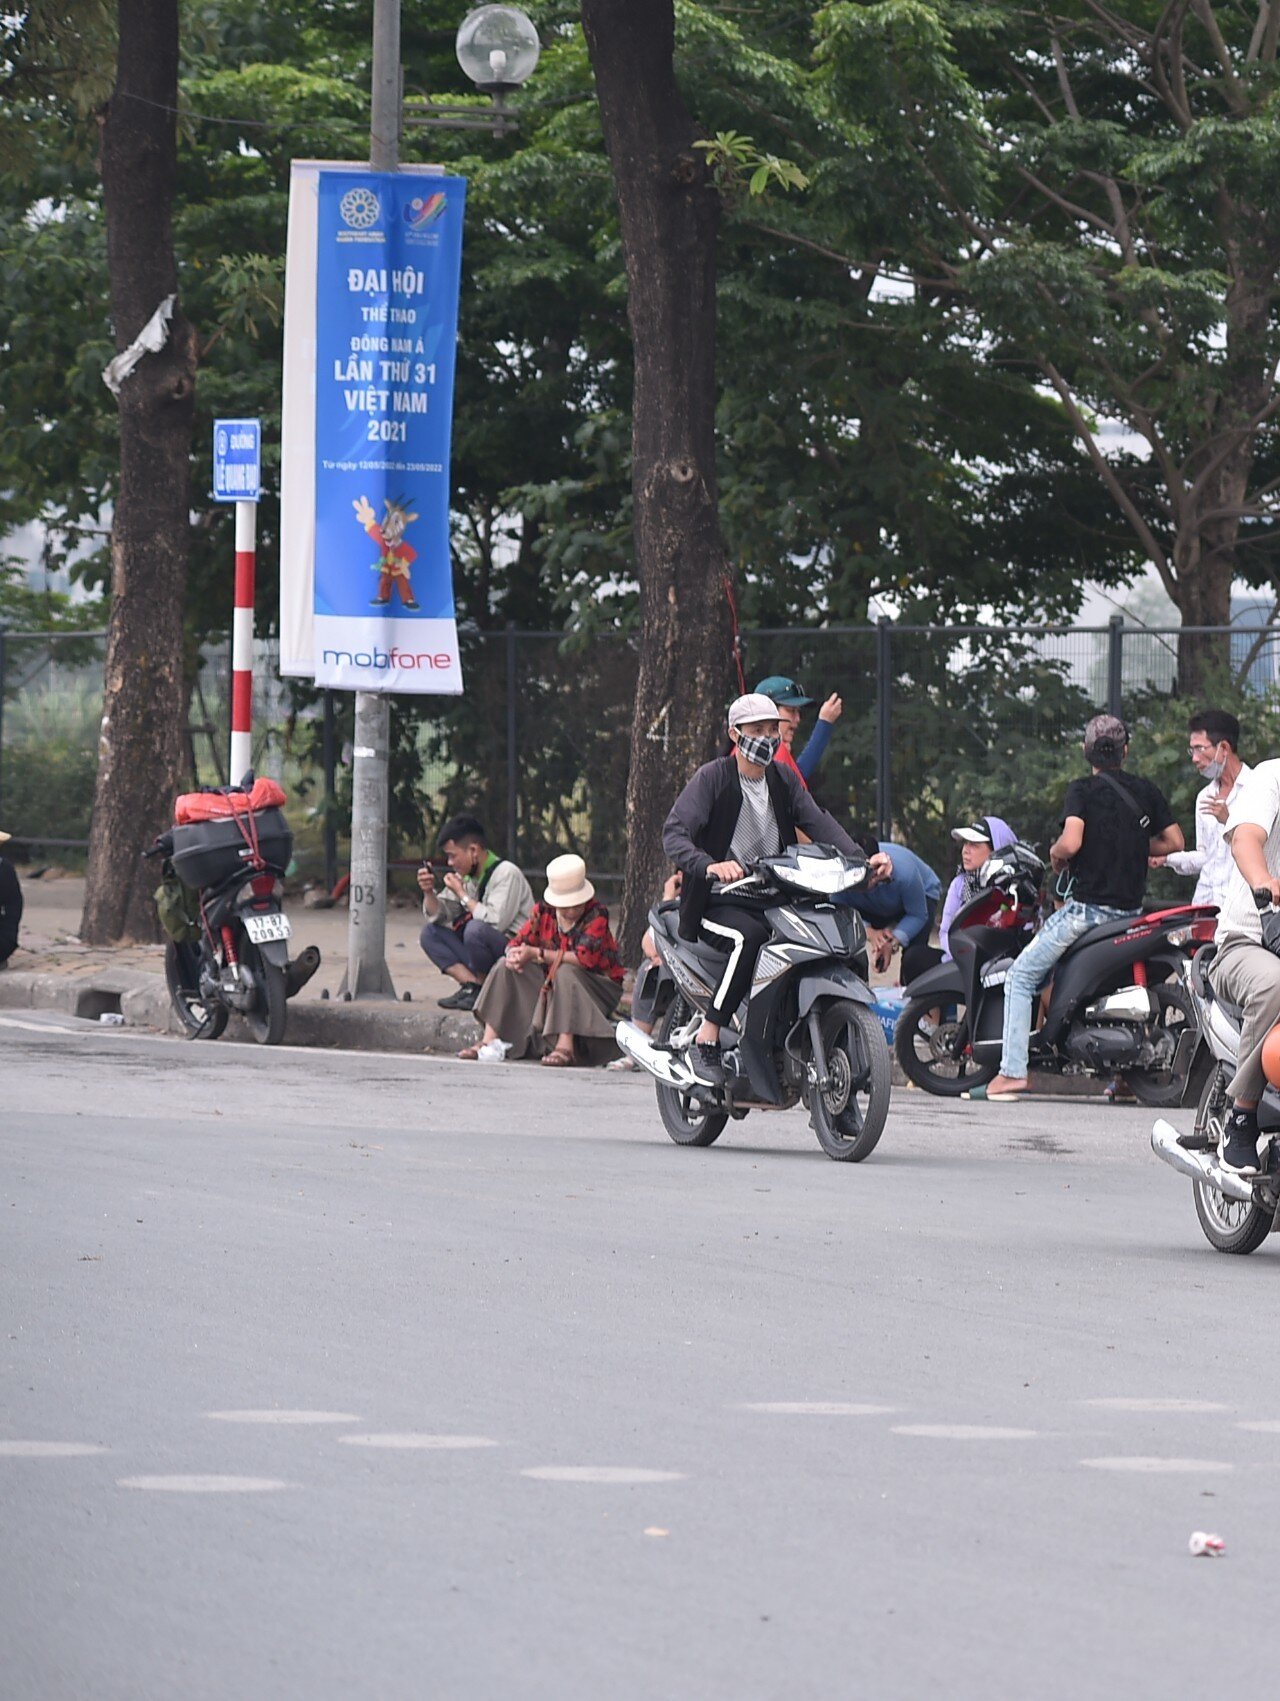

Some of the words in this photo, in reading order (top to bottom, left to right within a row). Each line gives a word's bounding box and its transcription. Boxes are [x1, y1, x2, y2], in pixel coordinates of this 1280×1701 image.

[347, 269, 387, 297] ĐẠI
[392, 265, 424, 299] HỘI
[361, 301, 388, 322] THỂ
[390, 308, 417, 324] THAO
[350, 333, 389, 352] ĐÔNG
[391, 338, 413, 353] NAM
[334, 352, 373, 382] LẦN
[379, 357, 411, 383] THỨ
[414, 363, 436, 384] 31
[344, 384, 390, 416] VIỆT
[393, 391, 427, 413] NAM
[367, 420, 406, 442] 2021
[323, 647, 451, 670] mobifone
